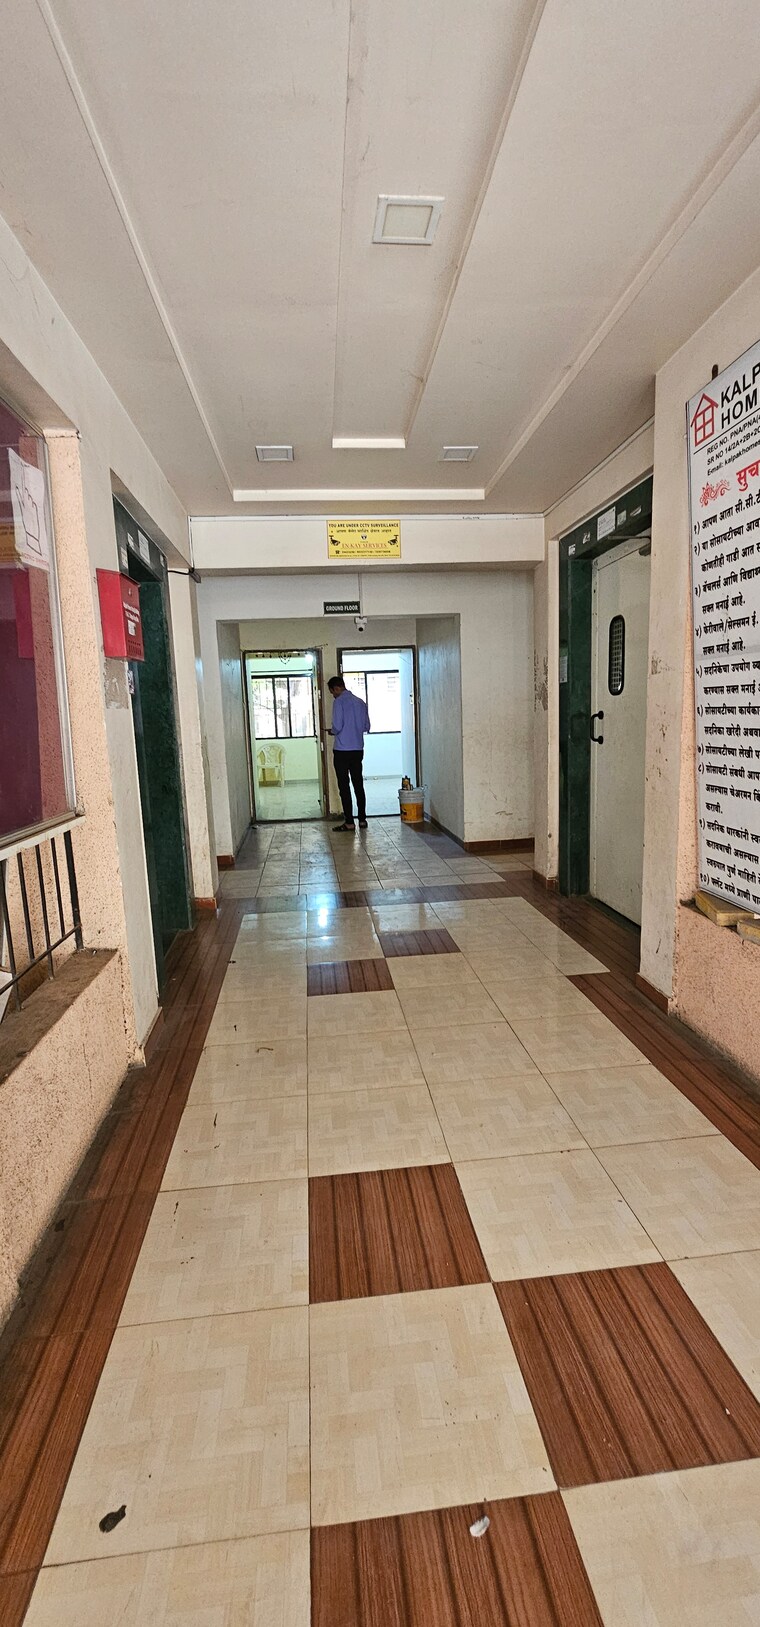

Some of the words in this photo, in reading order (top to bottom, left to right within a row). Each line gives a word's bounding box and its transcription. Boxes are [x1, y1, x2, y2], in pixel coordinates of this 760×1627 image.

[721, 362, 760, 408] KALP
[721, 388, 758, 429] HOM
[706, 443, 719, 455] REG
[720, 436, 729, 447] NO.
[707, 456, 714, 466] SR
[715, 450, 724, 461] NO
[702, 514, 717, 529] आपण
[719, 506, 733, 520] आता
[701, 553, 724, 572] कोणतीही
[741, 545, 754, 558] आत
[723, 571, 738, 587] आणि
[715, 595, 729, 611] मनाई
[731, 591, 746, 606] आहे.
[732, 637, 746, 651] आहे.
[741, 679, 755, 696] मनाई
[704, 723, 724, 735] सदनिका
[706, 762, 728, 776] सोसायटी
